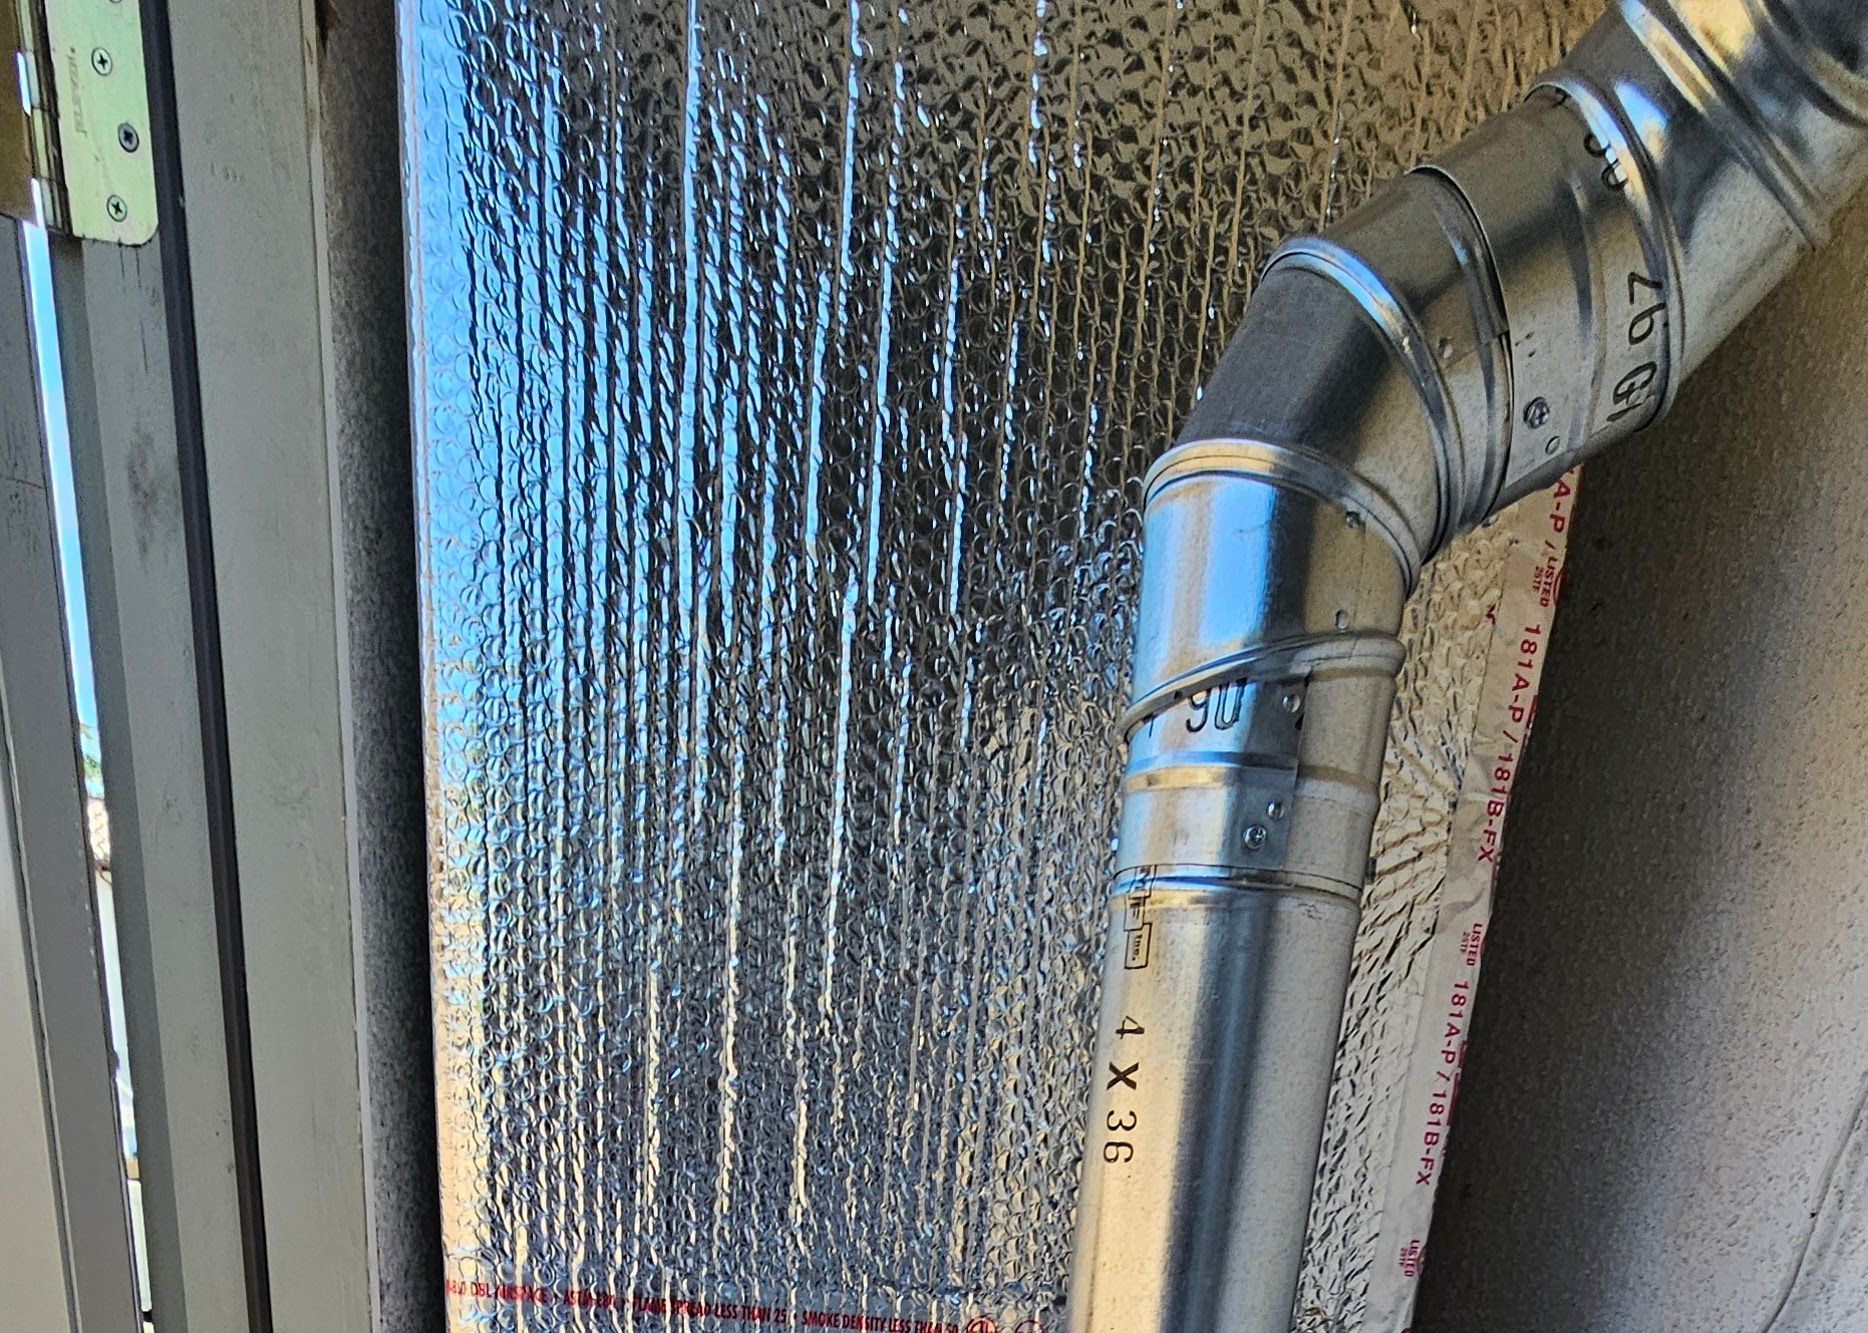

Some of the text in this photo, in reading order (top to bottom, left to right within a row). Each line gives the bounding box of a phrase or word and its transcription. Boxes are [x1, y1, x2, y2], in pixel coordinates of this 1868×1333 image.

[1540, 557, 1557, 607] LISTED
[1508, 624, 1541, 723] 181A-P
[1478, 753, 1513, 862] 181B-FX
[1466, 923, 1482, 966] LISTED
[1115, 1015, 1145, 1040] 4
[1441, 981, 1468, 1065] 181A-P
[1104, 1110, 1137, 1163] 36
[1416, 1090, 1447, 1185] 181B-FX
[1404, 1240, 1420, 1277] LISTED
[714, 1304, 738, 1320] LESS
[742, 1306, 771, 1323] THAN
[774, 1309, 787, 1324] 25
[801, 1310, 840, 1328] SMOKE
[841, 1312, 885, 1332] DENSITY
